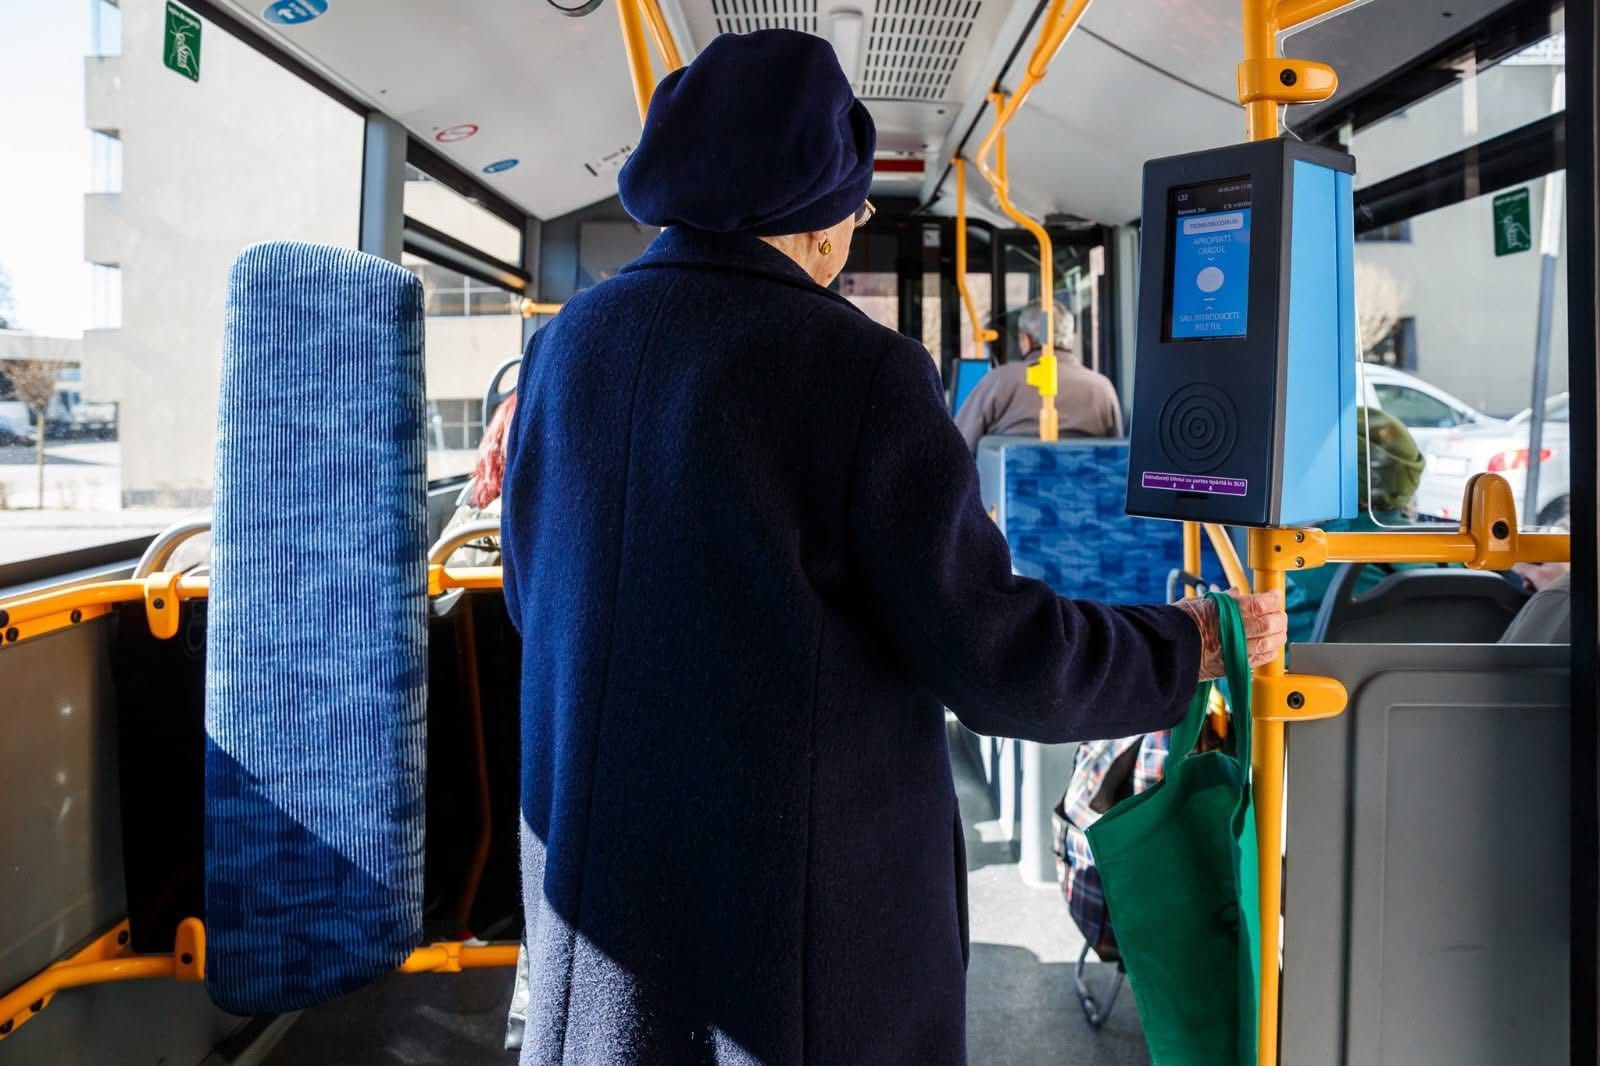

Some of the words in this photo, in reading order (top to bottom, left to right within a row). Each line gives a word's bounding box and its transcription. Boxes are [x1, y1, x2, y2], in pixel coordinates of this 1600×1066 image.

[1197, 246, 1225, 256] CARDUL
[1179, 314, 1192, 322] SAU
[1195, 322, 1222, 331] BILETUL
